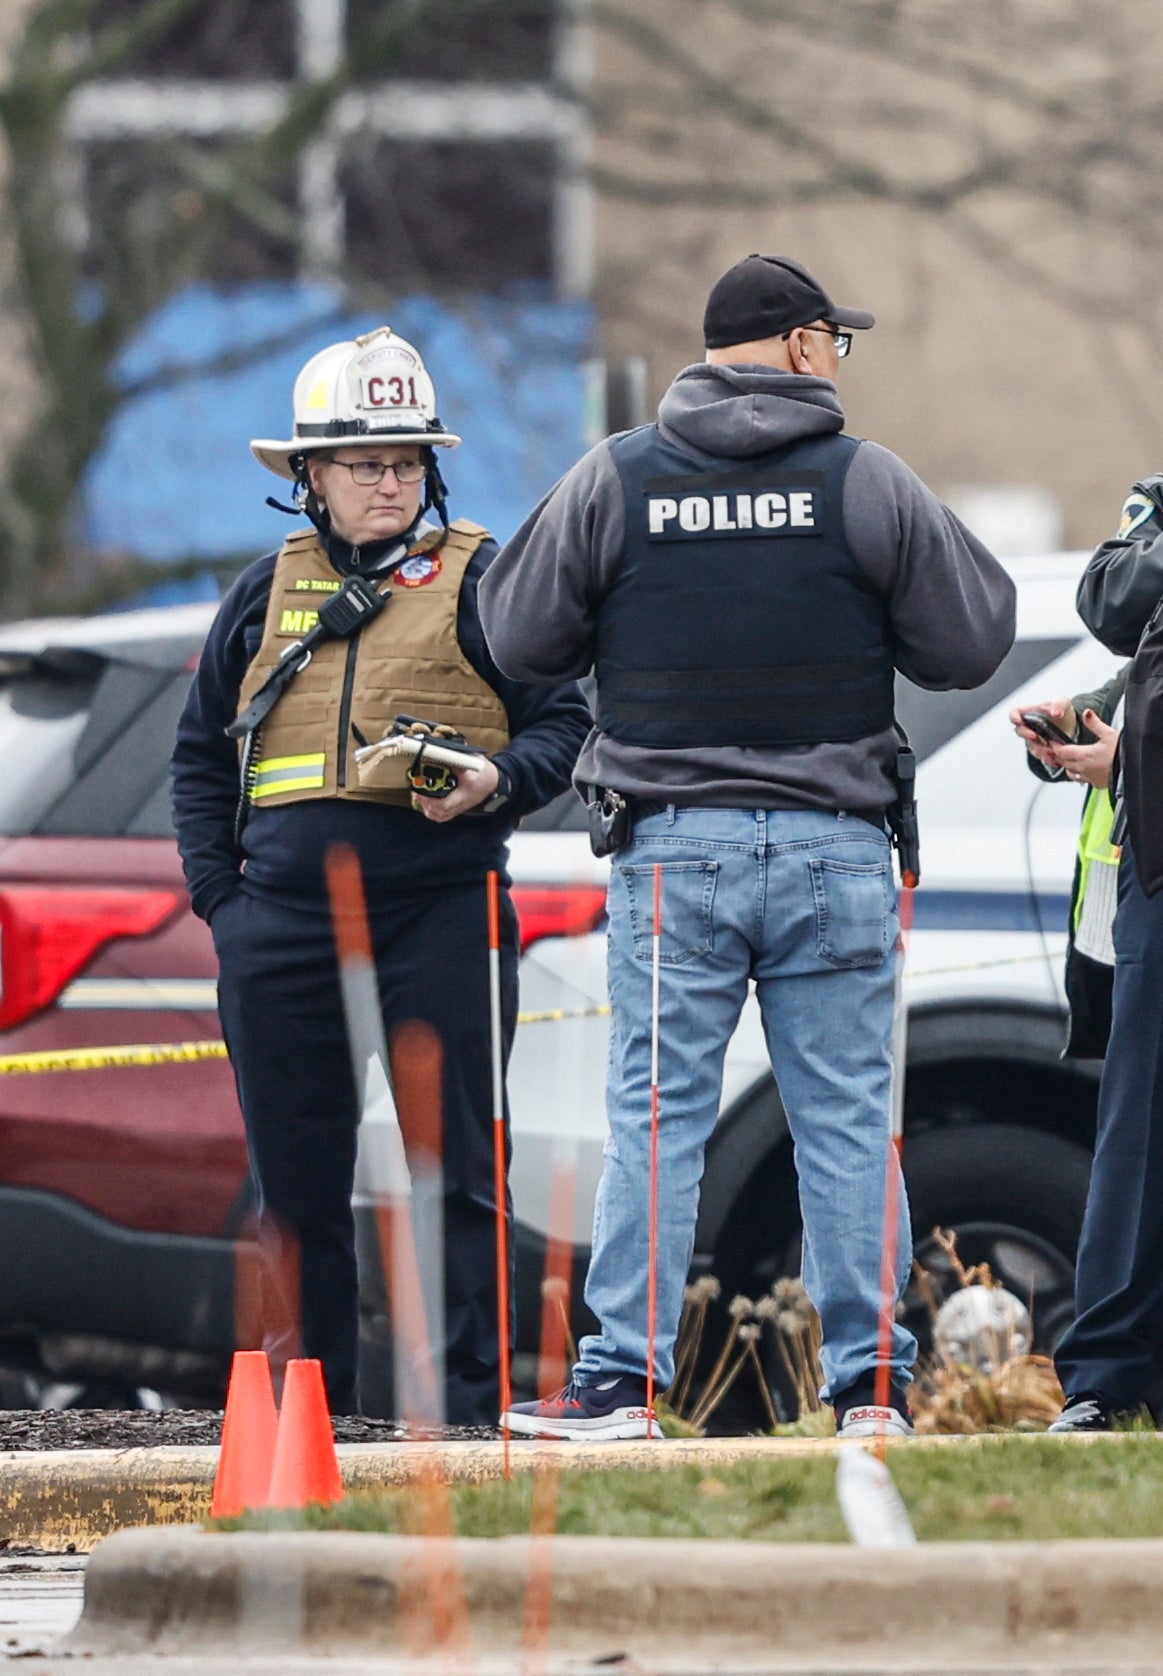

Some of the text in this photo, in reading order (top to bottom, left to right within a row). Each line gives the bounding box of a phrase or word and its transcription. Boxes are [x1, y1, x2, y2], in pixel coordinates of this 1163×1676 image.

[368, 376, 417, 406] C31
[648, 492, 815, 534] POLICE
[295, 580, 340, 591] DC TATAR
[280, 610, 319, 632] MF
[849, 1408, 892, 1421] adidas
